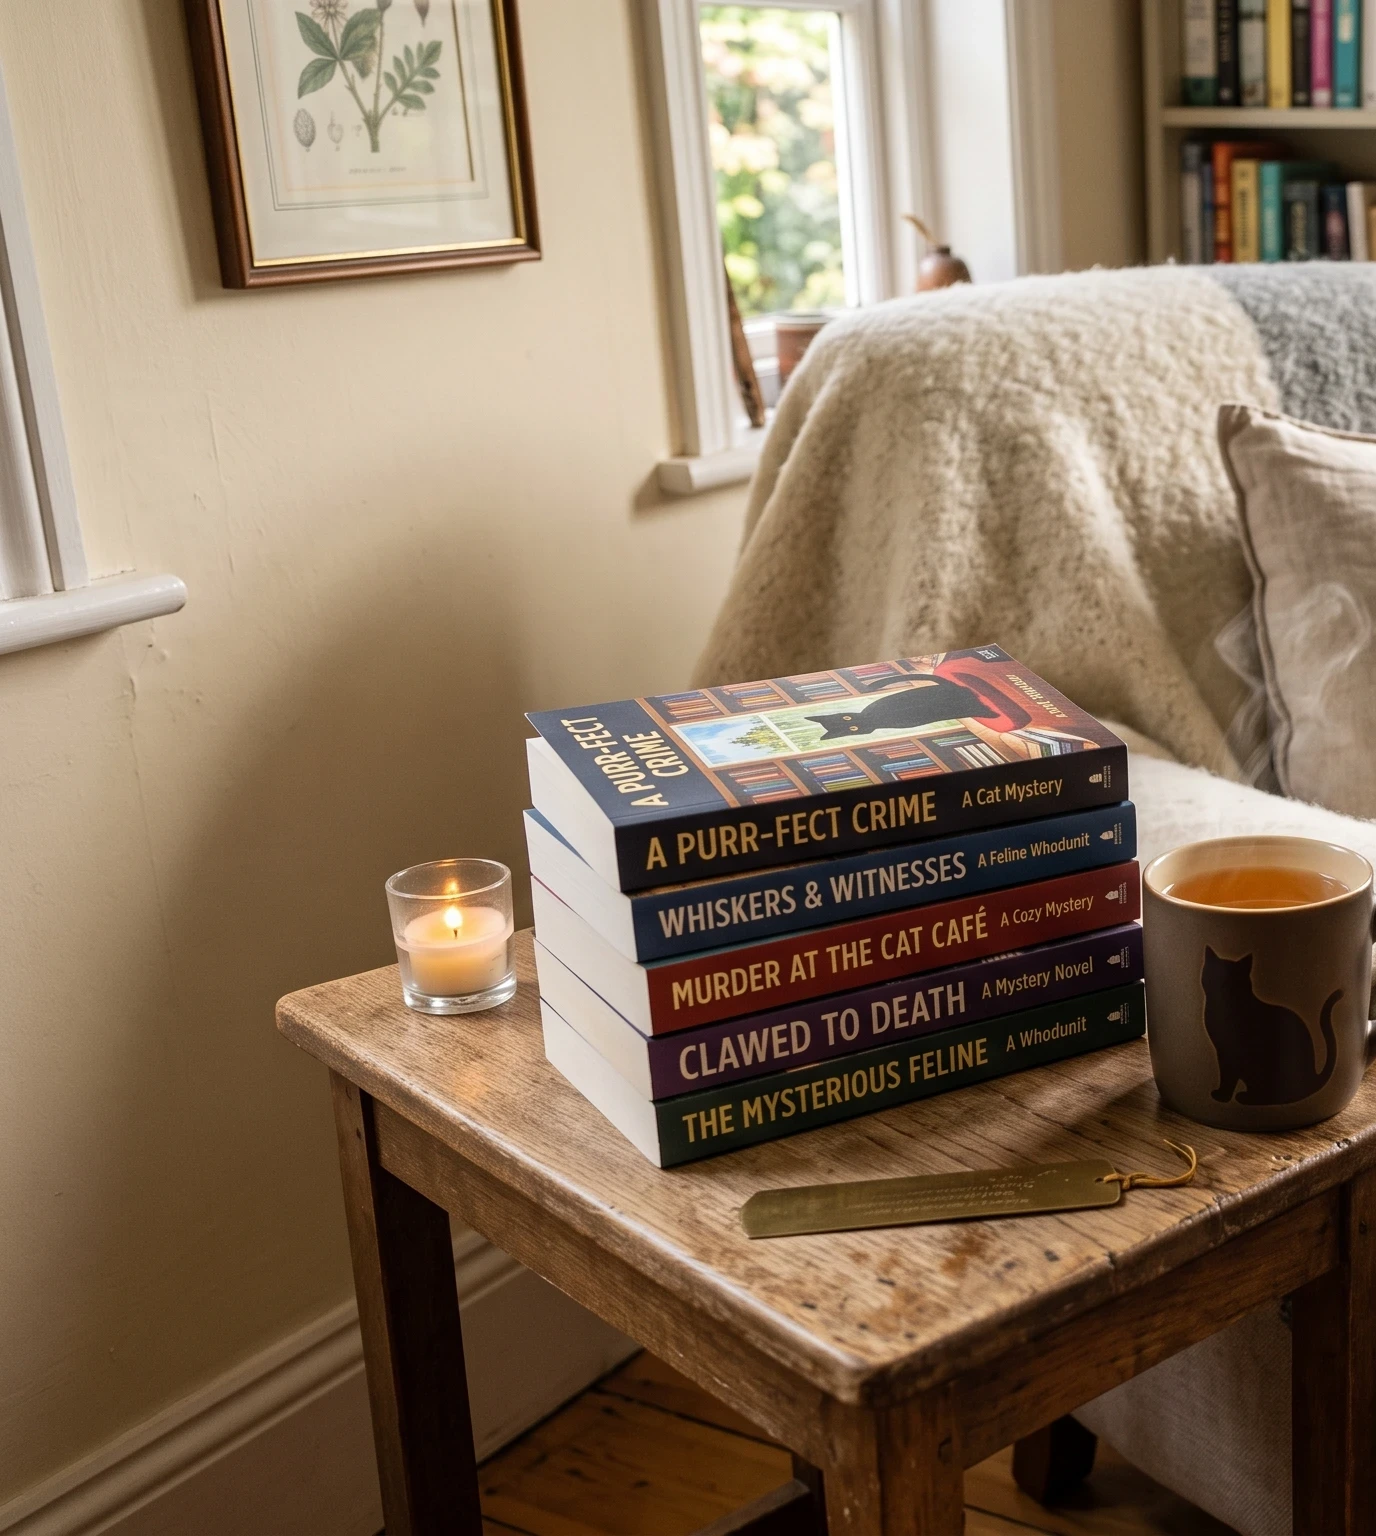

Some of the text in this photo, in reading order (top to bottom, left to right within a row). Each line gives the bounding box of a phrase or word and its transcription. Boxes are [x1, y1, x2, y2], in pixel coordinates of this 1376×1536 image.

[560, 716, 670, 807] A PURR-FECT
[621, 730, 689, 778] CRIME
[962, 778, 1063, 808] A Cat Mystery
[646, 791, 938, 870] A PURR-FECT CRIME
[978, 832, 1090, 868] A Feline Whodunit
[658, 851, 967, 938] WHISKERS & WITNESSES
[1000, 895, 1094, 927] A Cozy Mystery
[671, 905, 989, 1010] MURDER AT THE CAT CAFÉ
[981, 982, 992, 999] A
[995, 970, 1051, 996] Mystery
[1055, 955, 1094, 982] Novel
[679, 981, 966, 1081] CLAWED TO DEATH
[1006, 1015, 1087, 1052] A Whodunit
[682, 1037, 989, 1143] THE MYSTERIOUS FELINE
